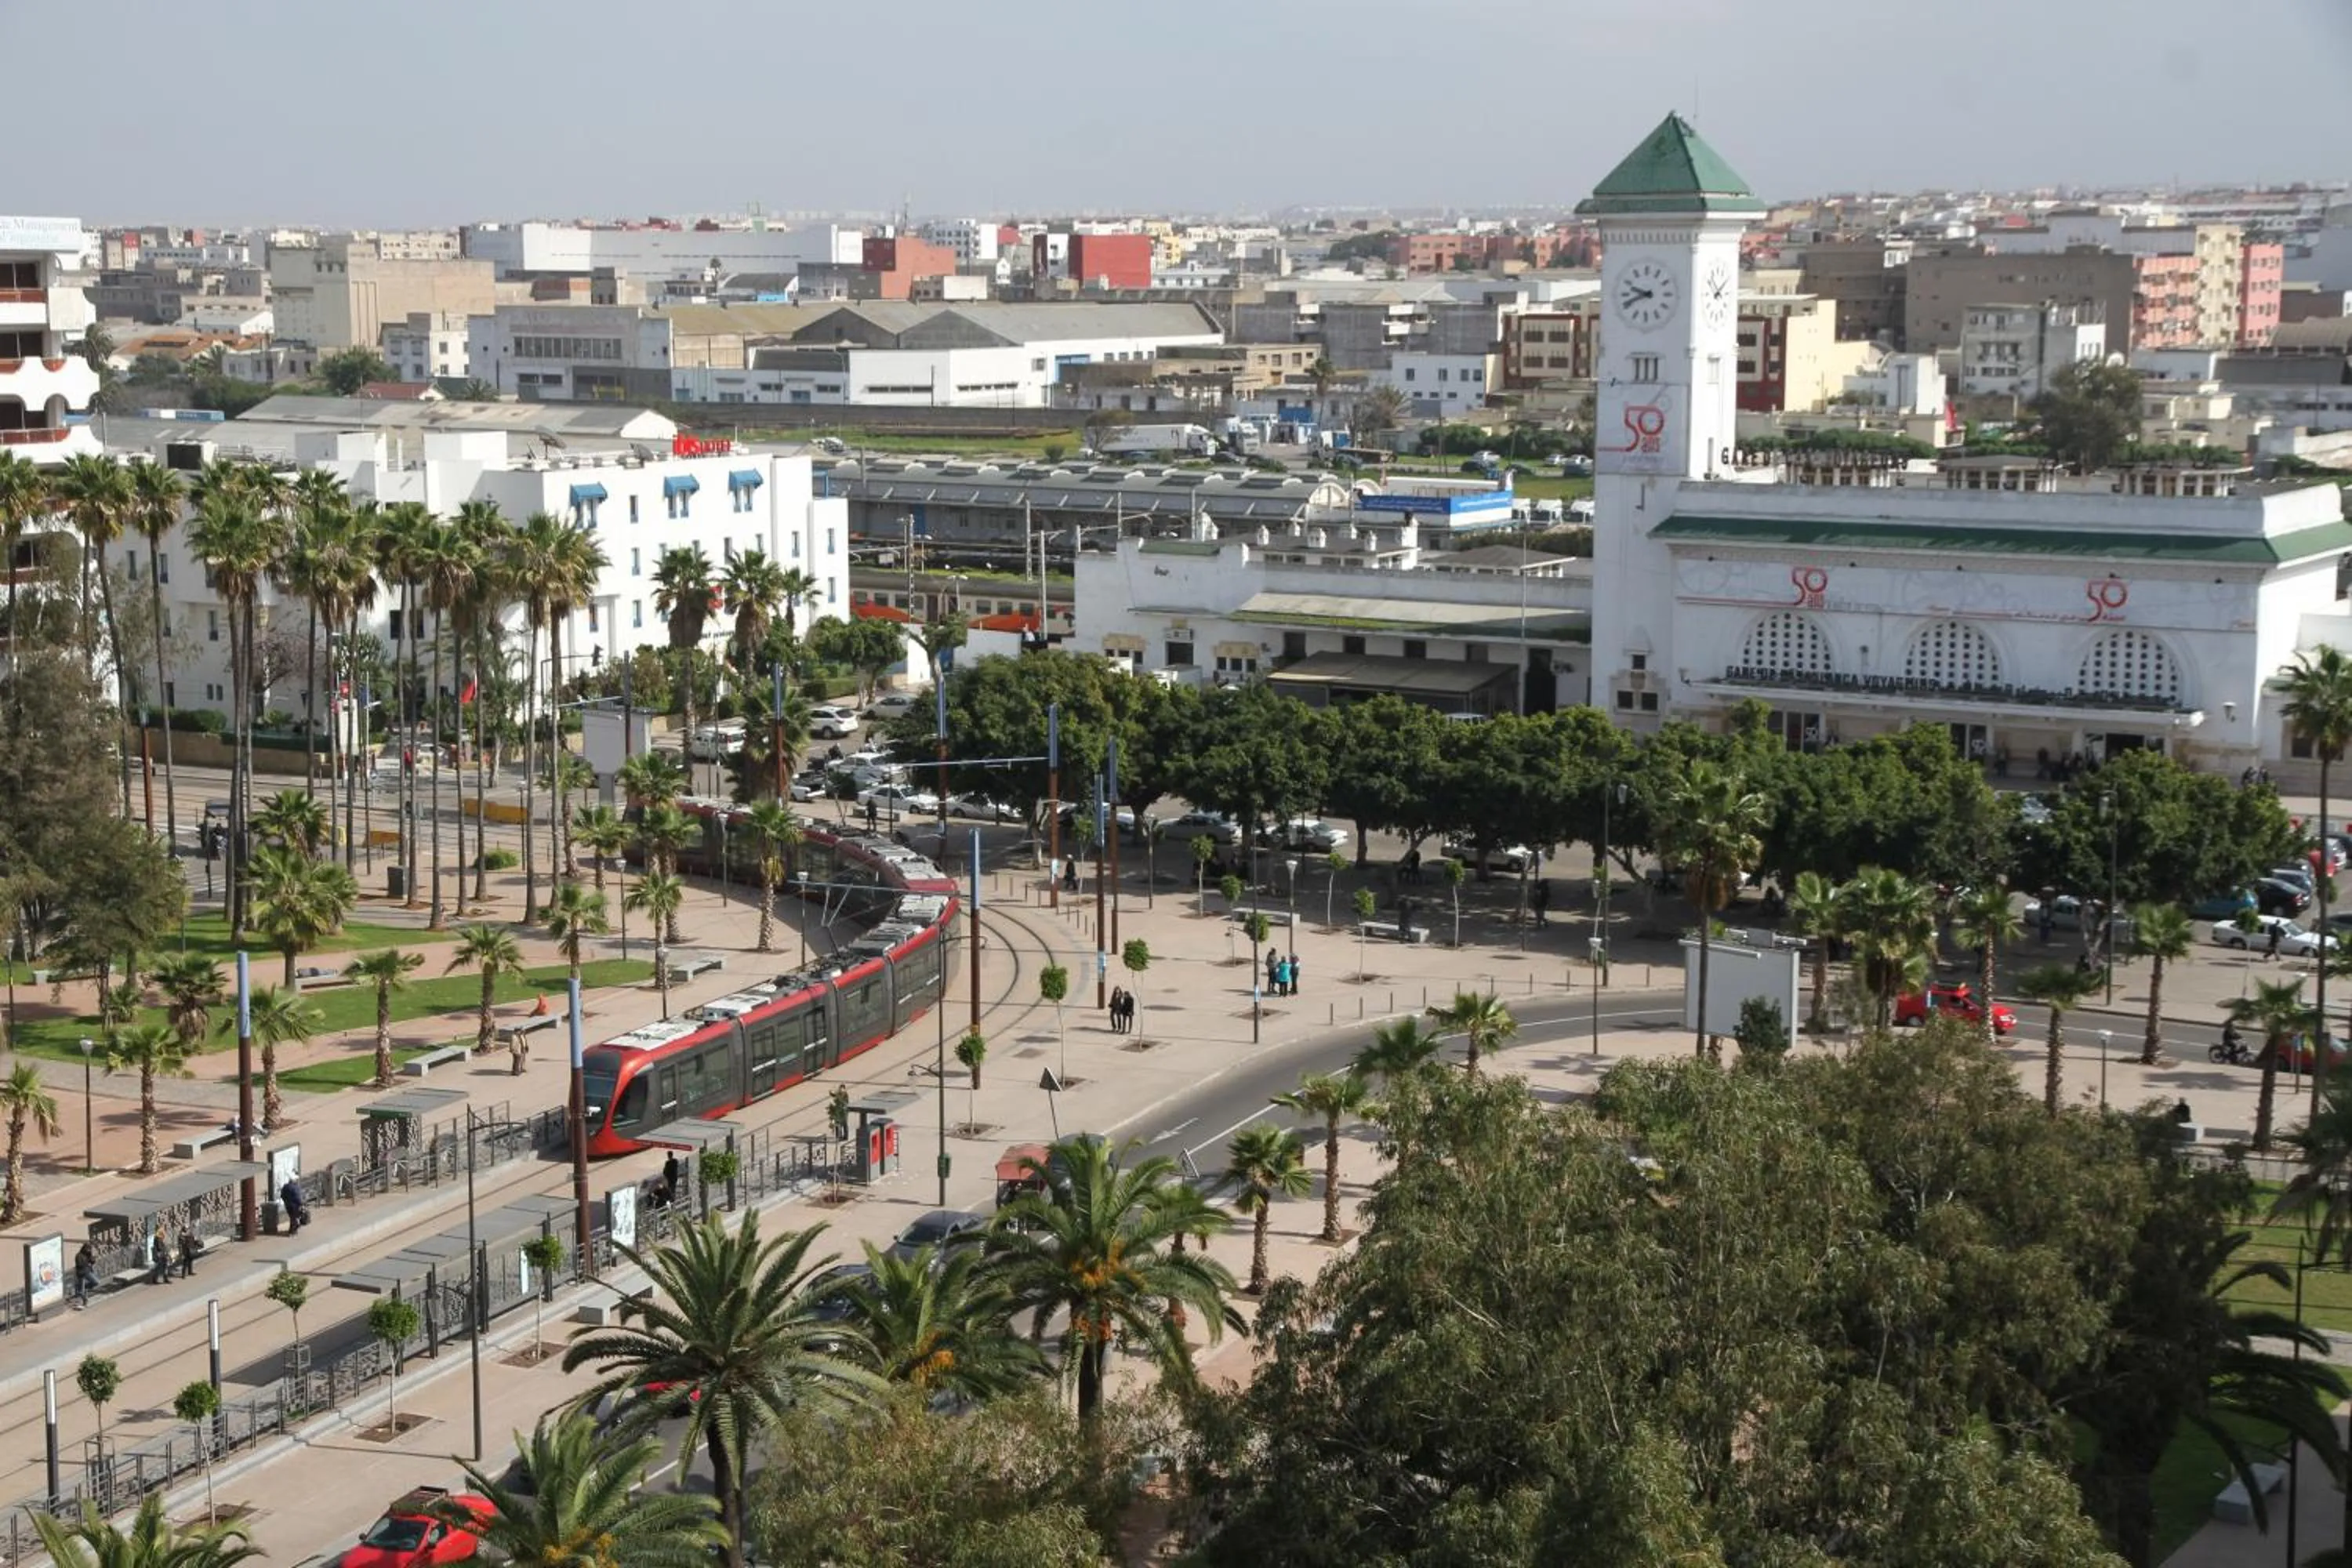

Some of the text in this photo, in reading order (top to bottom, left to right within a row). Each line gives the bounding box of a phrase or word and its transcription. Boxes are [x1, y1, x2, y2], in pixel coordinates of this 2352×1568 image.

[1624, 405, 1664, 452] 50
[1722, 447, 1761, 466] GARE
[1792, 567, 1828, 605] 50
[2086, 579, 2127, 622] 50
[1726, 665, 1756, 679] GARE
[1780, 669, 1858, 686] LANCA
